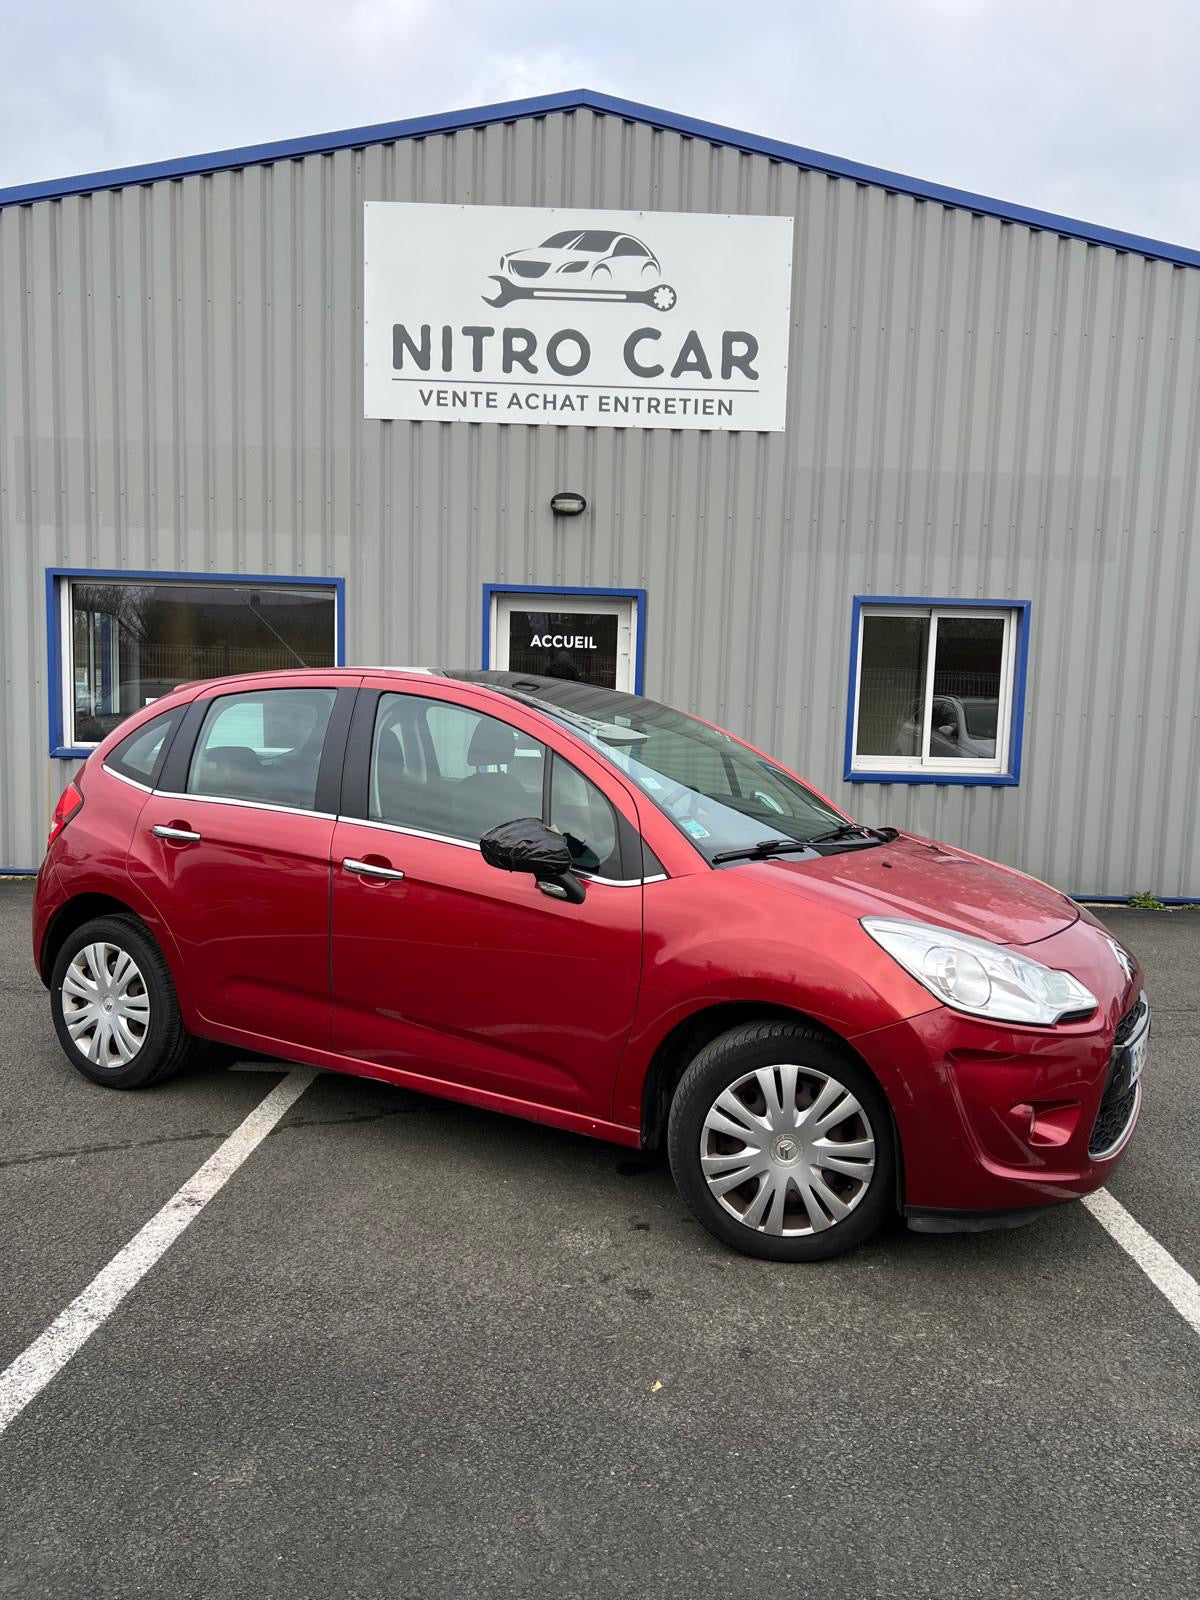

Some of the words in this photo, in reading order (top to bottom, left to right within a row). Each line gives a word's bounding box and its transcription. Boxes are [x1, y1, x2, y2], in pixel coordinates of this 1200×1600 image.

[392, 323, 591, 377] NITRO
[623, 327, 760, 381] CAR
[418, 389, 498, 409] VENTE
[506, 392, 589, 412] ACHAT
[598, 396, 734, 416] ENTRETIEN
[530, 634, 597, 649] ACCUEIL
